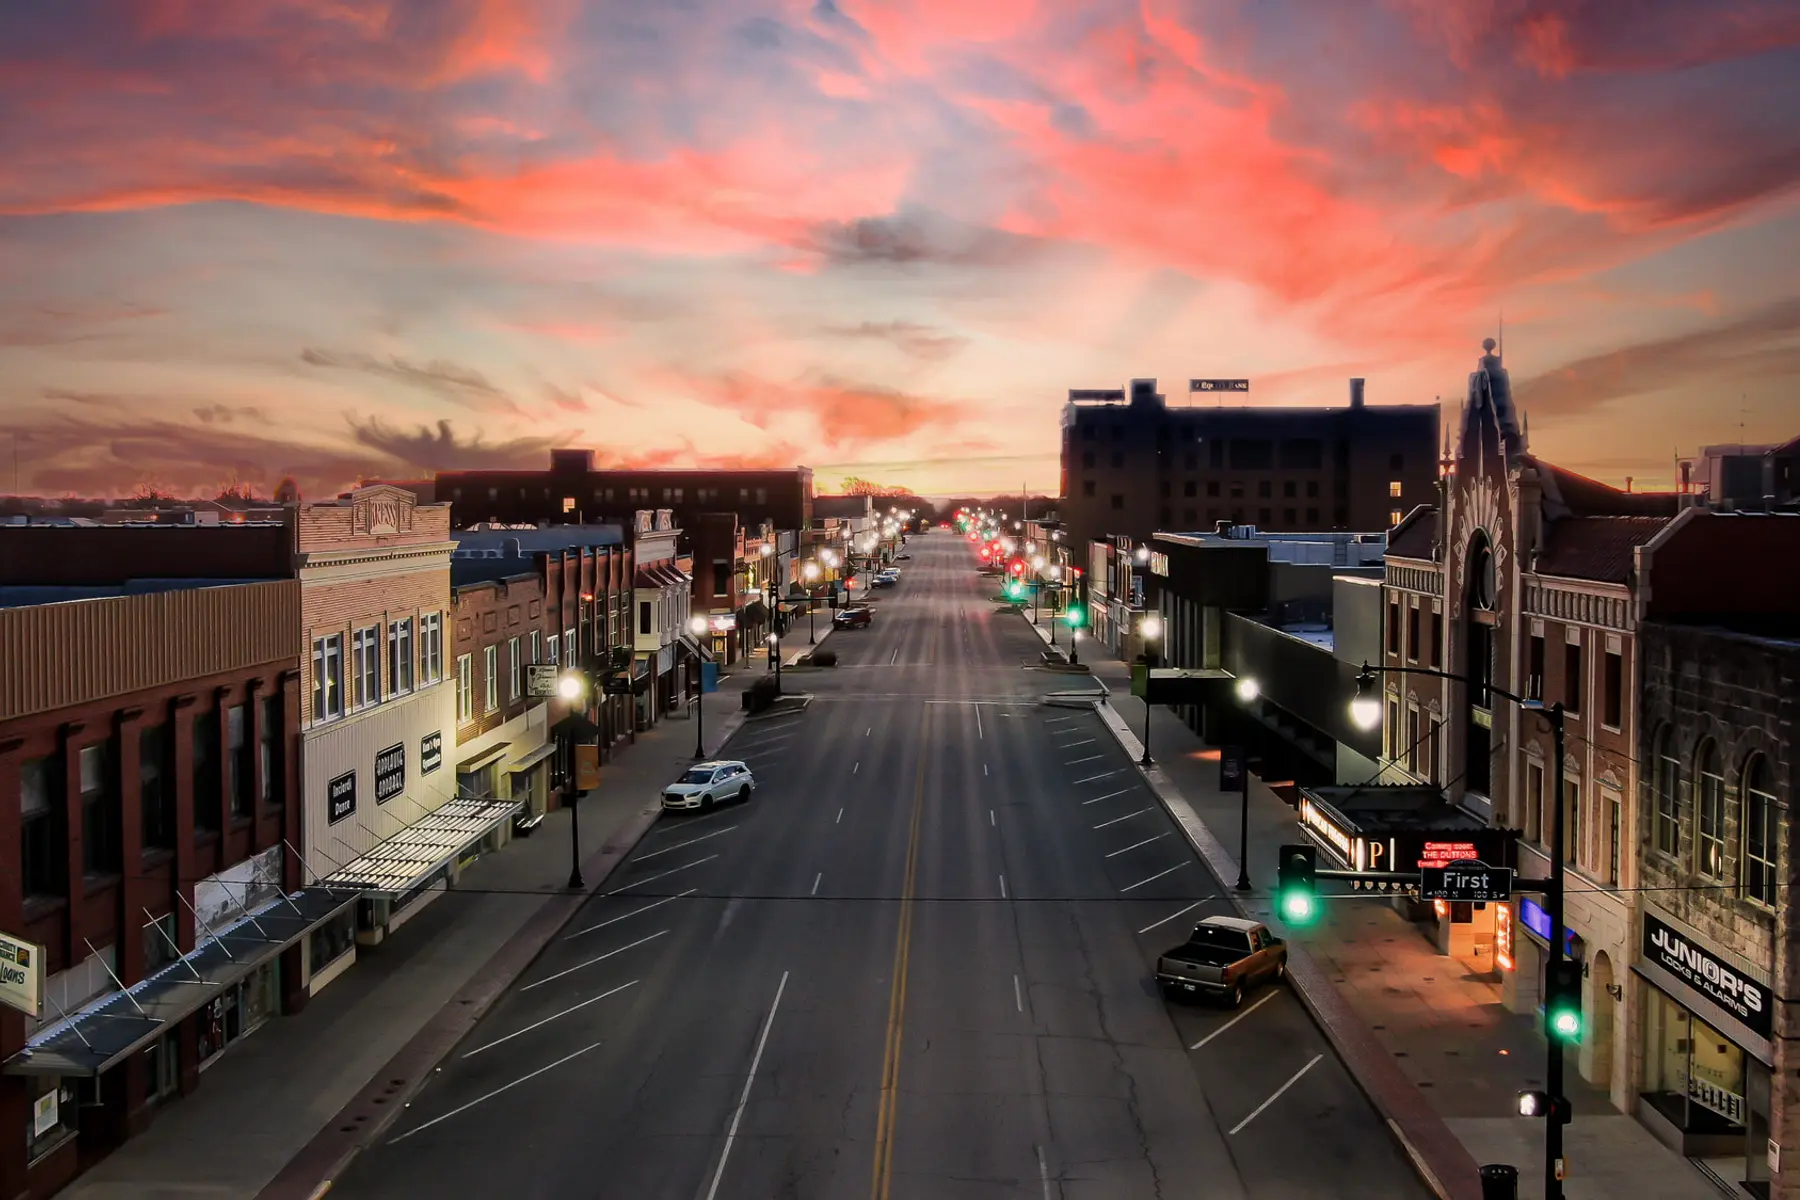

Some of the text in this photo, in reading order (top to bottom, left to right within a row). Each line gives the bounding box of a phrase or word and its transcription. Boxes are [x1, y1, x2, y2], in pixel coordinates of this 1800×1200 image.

[1369, 841, 1384, 868] P
[1422, 851, 1477, 859] THE DUTTONS
[1443, 872, 1489, 889] First
[1452, 890, 1458, 898] N
[1474, 890, 1488, 898] 100
[1651, 928, 1762, 1013] JUNIOR'S
[1660, 951, 1749, 1018] LOCKS & ALARMS
